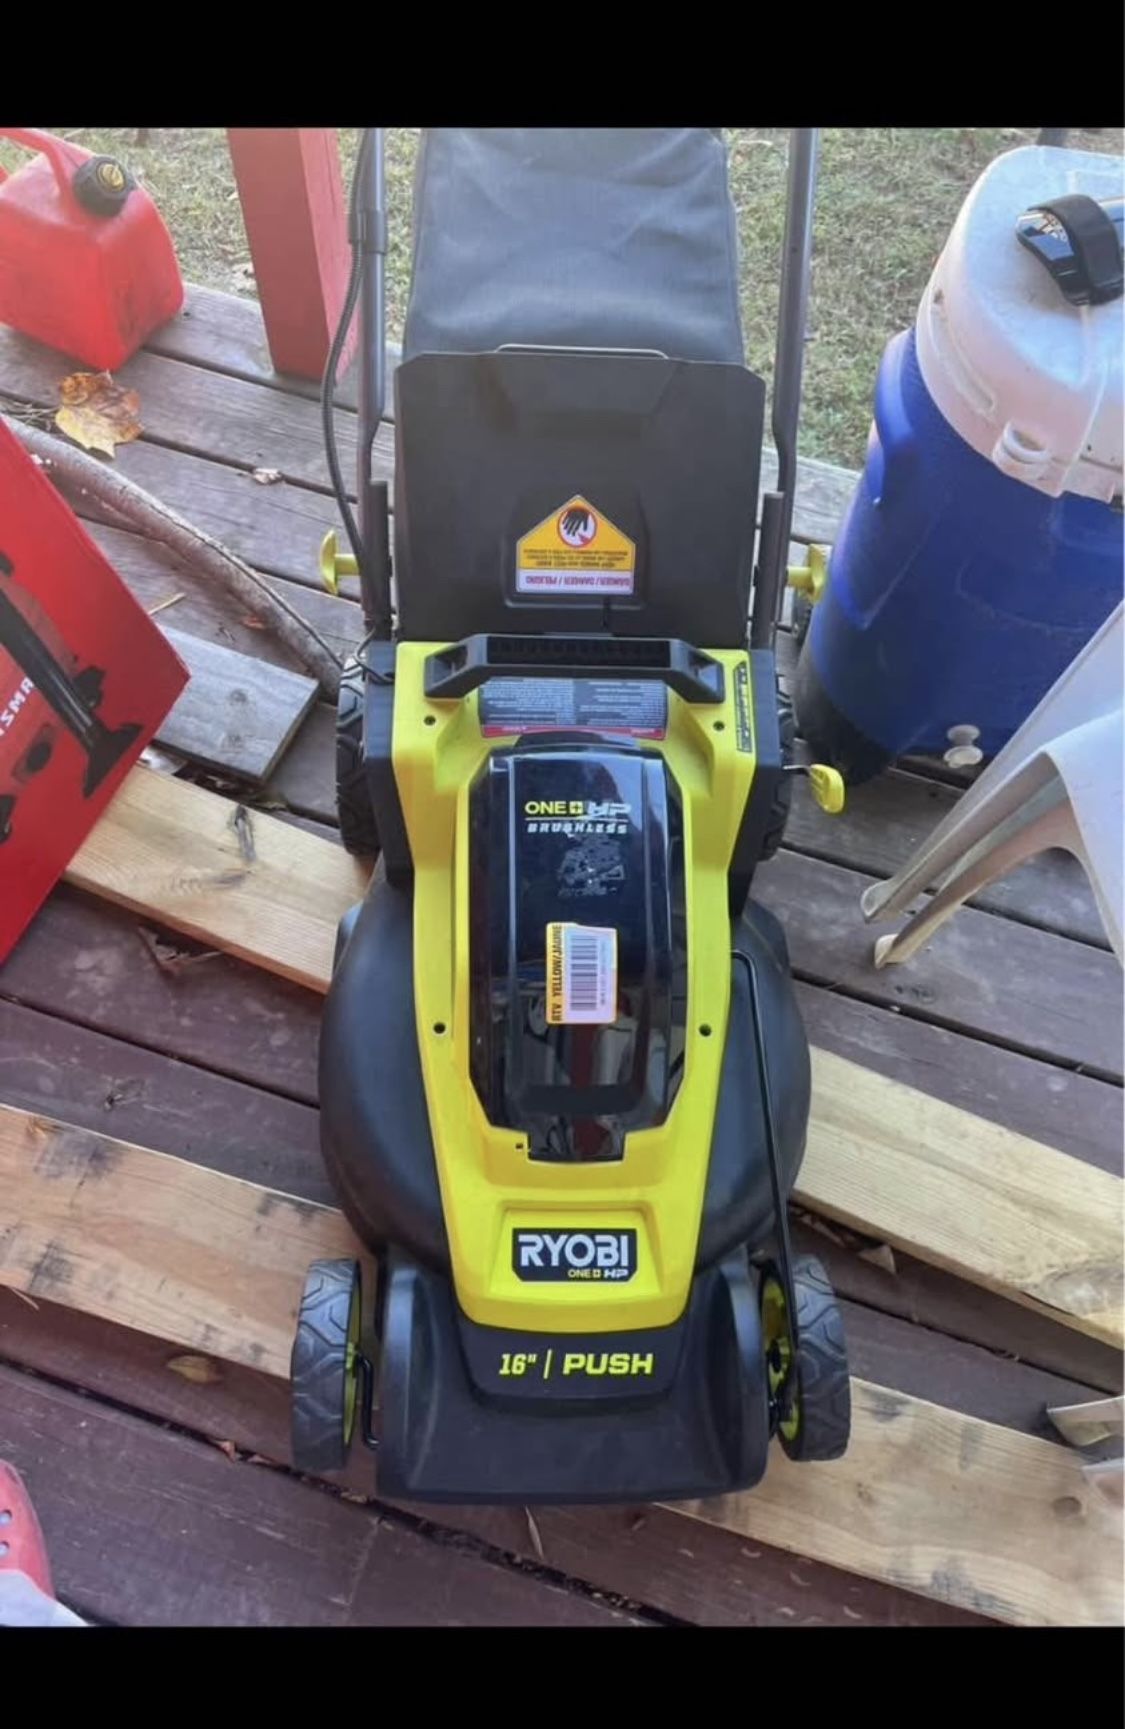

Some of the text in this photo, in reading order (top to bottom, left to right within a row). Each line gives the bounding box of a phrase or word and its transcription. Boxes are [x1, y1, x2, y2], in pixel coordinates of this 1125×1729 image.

[526, 823, 628, 834] BRUSHLESS
[518, 1234, 629, 1267] RYOBI
[604, 1269, 629, 1279] HP
[499, 1353, 538, 1375] 16"
[562, 1353, 653, 1375] PUSH
